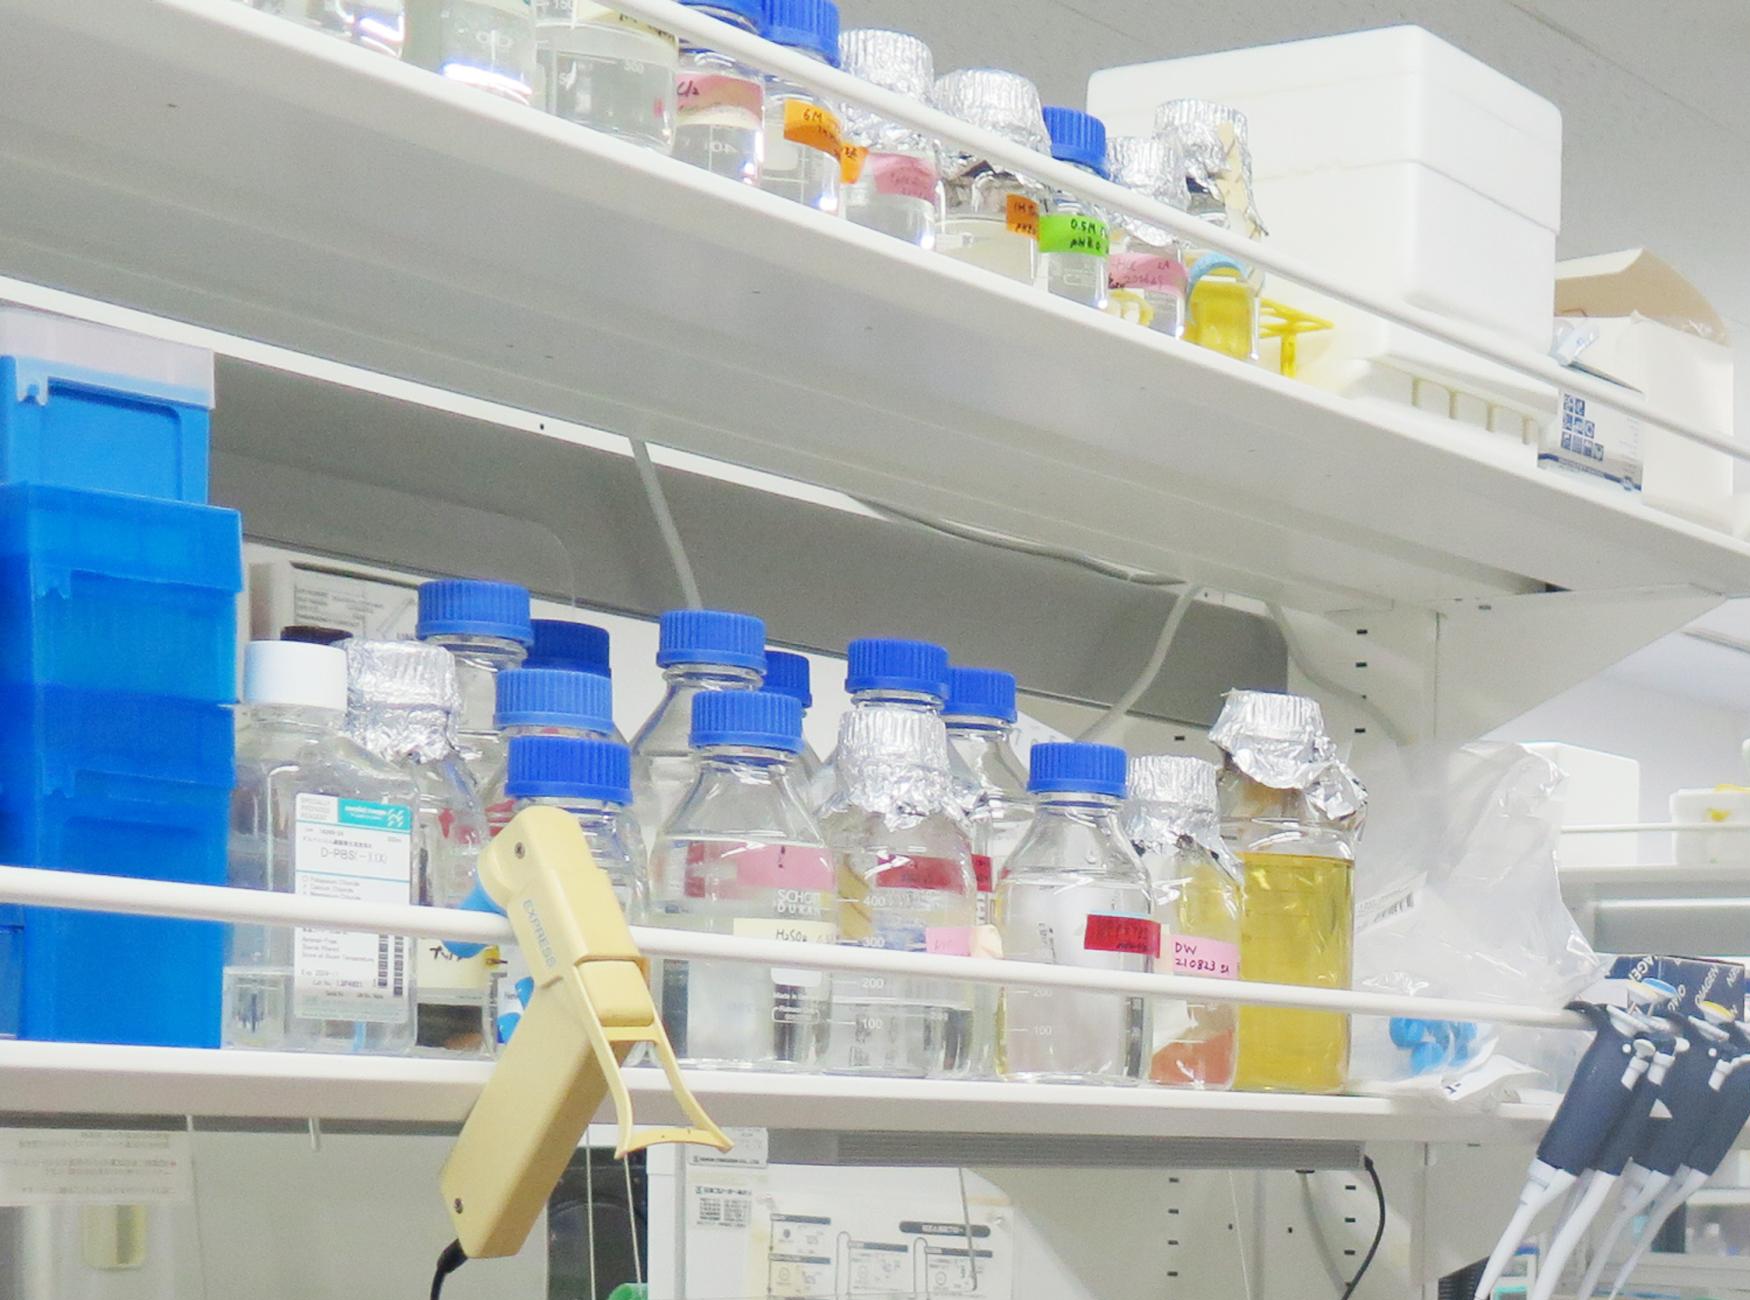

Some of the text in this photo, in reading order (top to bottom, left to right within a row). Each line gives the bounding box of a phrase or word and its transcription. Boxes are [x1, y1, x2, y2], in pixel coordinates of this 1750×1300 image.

[864, 894, 886, 907] 400
[523, 899, 557, 968] EXPRESS
[864, 936, 886, 948] 300
[1175, 941, 1197, 956] DW
[1175, 957, 1216, 972] 210823
[862, 977, 885, 989] 200
[863, 1017, 883, 1030] 100
[1034, 1024, 1054, 1036] 100
